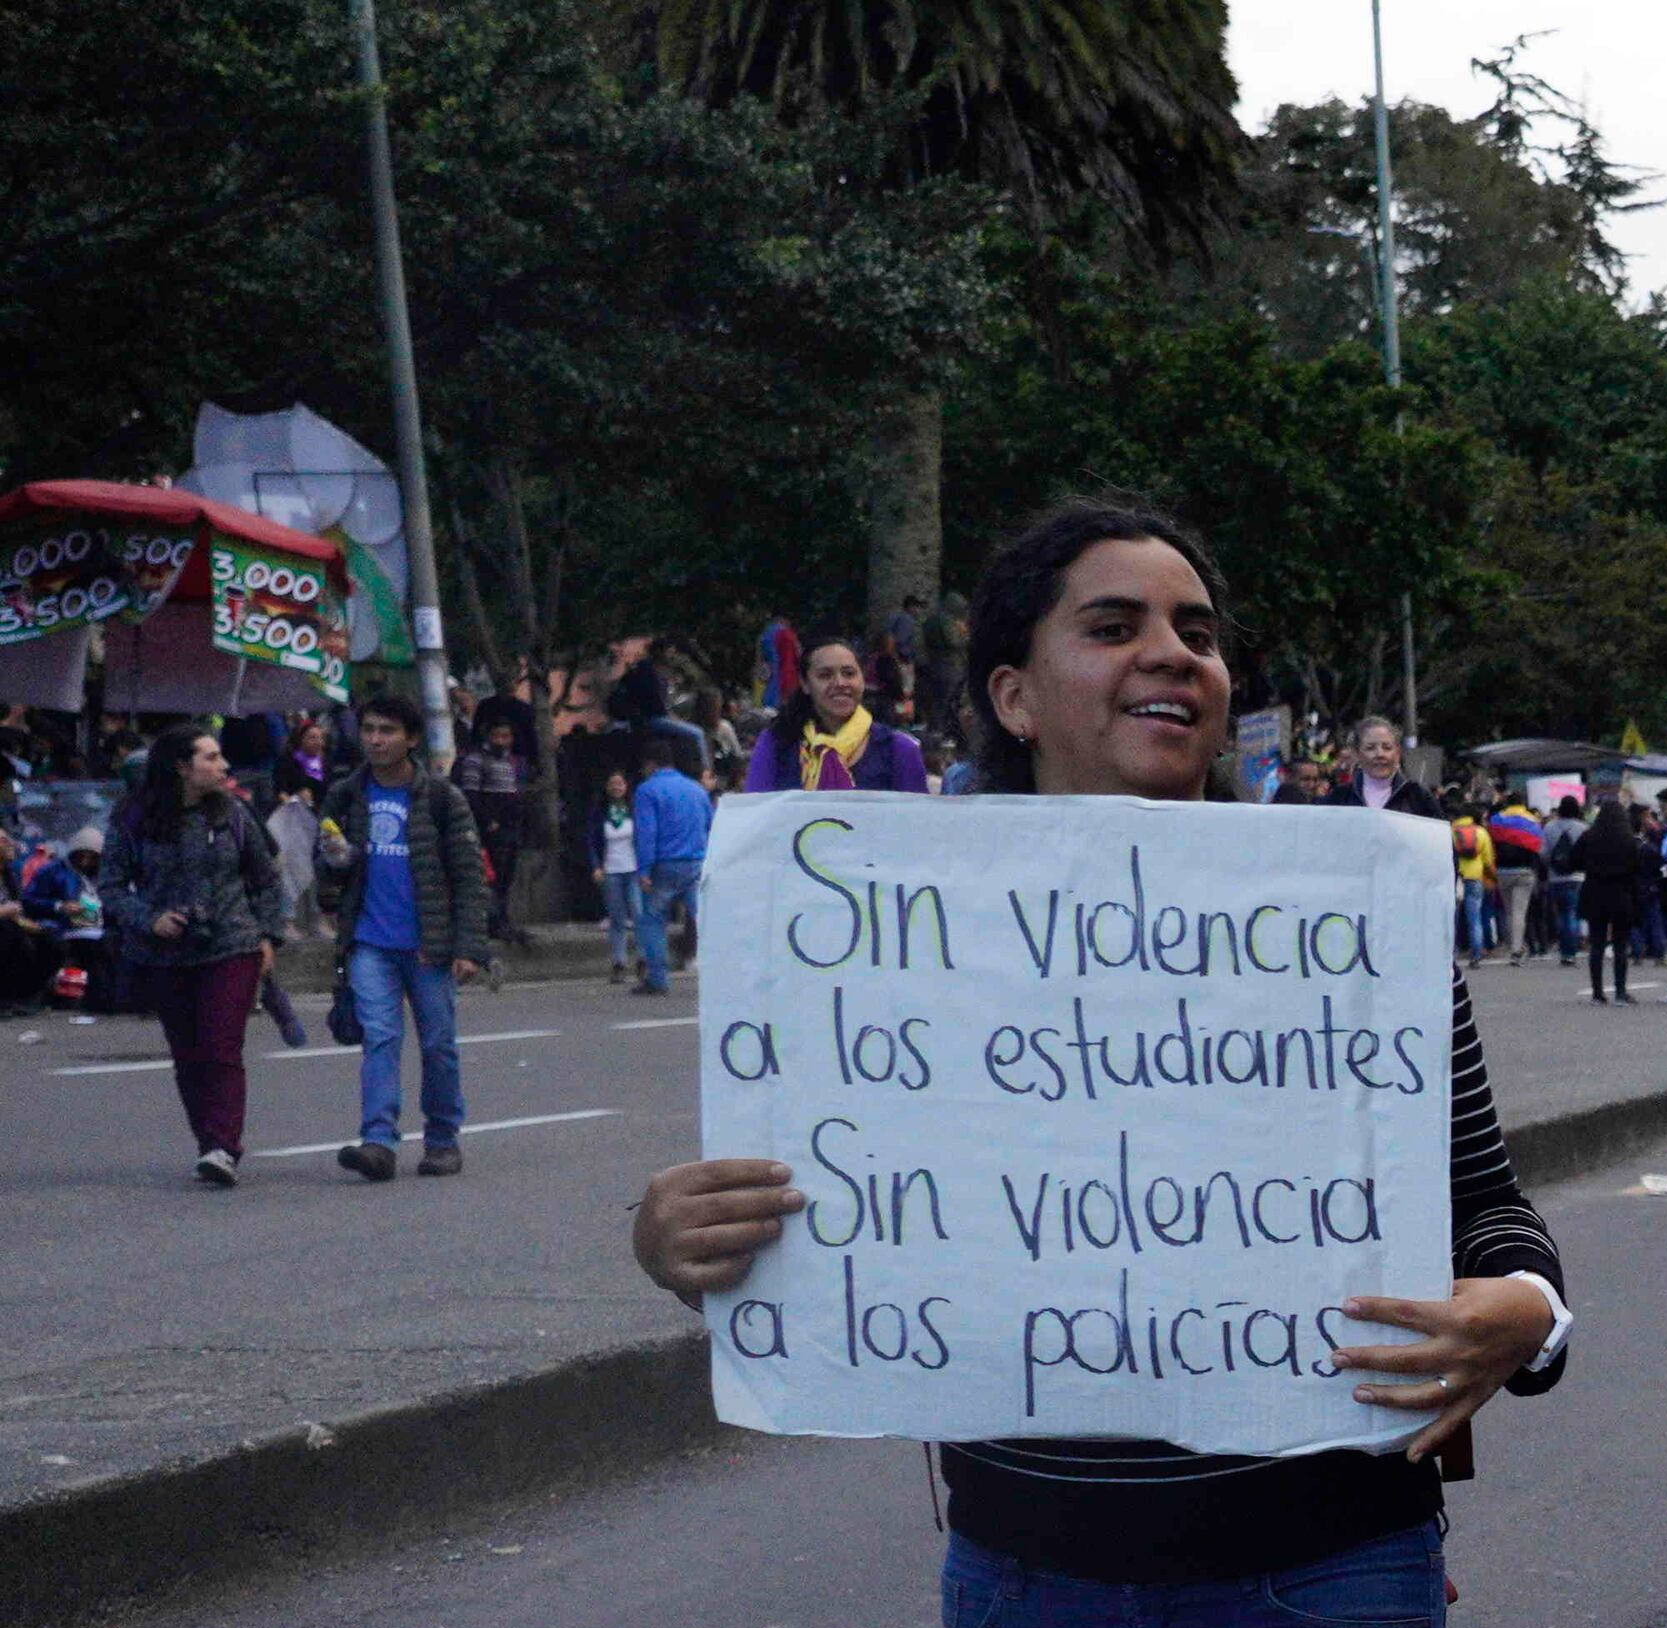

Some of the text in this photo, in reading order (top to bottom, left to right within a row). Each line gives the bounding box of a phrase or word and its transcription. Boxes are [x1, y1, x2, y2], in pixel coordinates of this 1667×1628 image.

[212, 550, 320, 602] 3.000
[214, 604, 318, 654] 3.500
[787, 817, 1380, 979] Sin violencia
[719, 986, 1425, 1102] a los estudiantes
[806, 1117, 1382, 1262] Sin violencia
[728, 1255, 1349, 1418] a los policías
